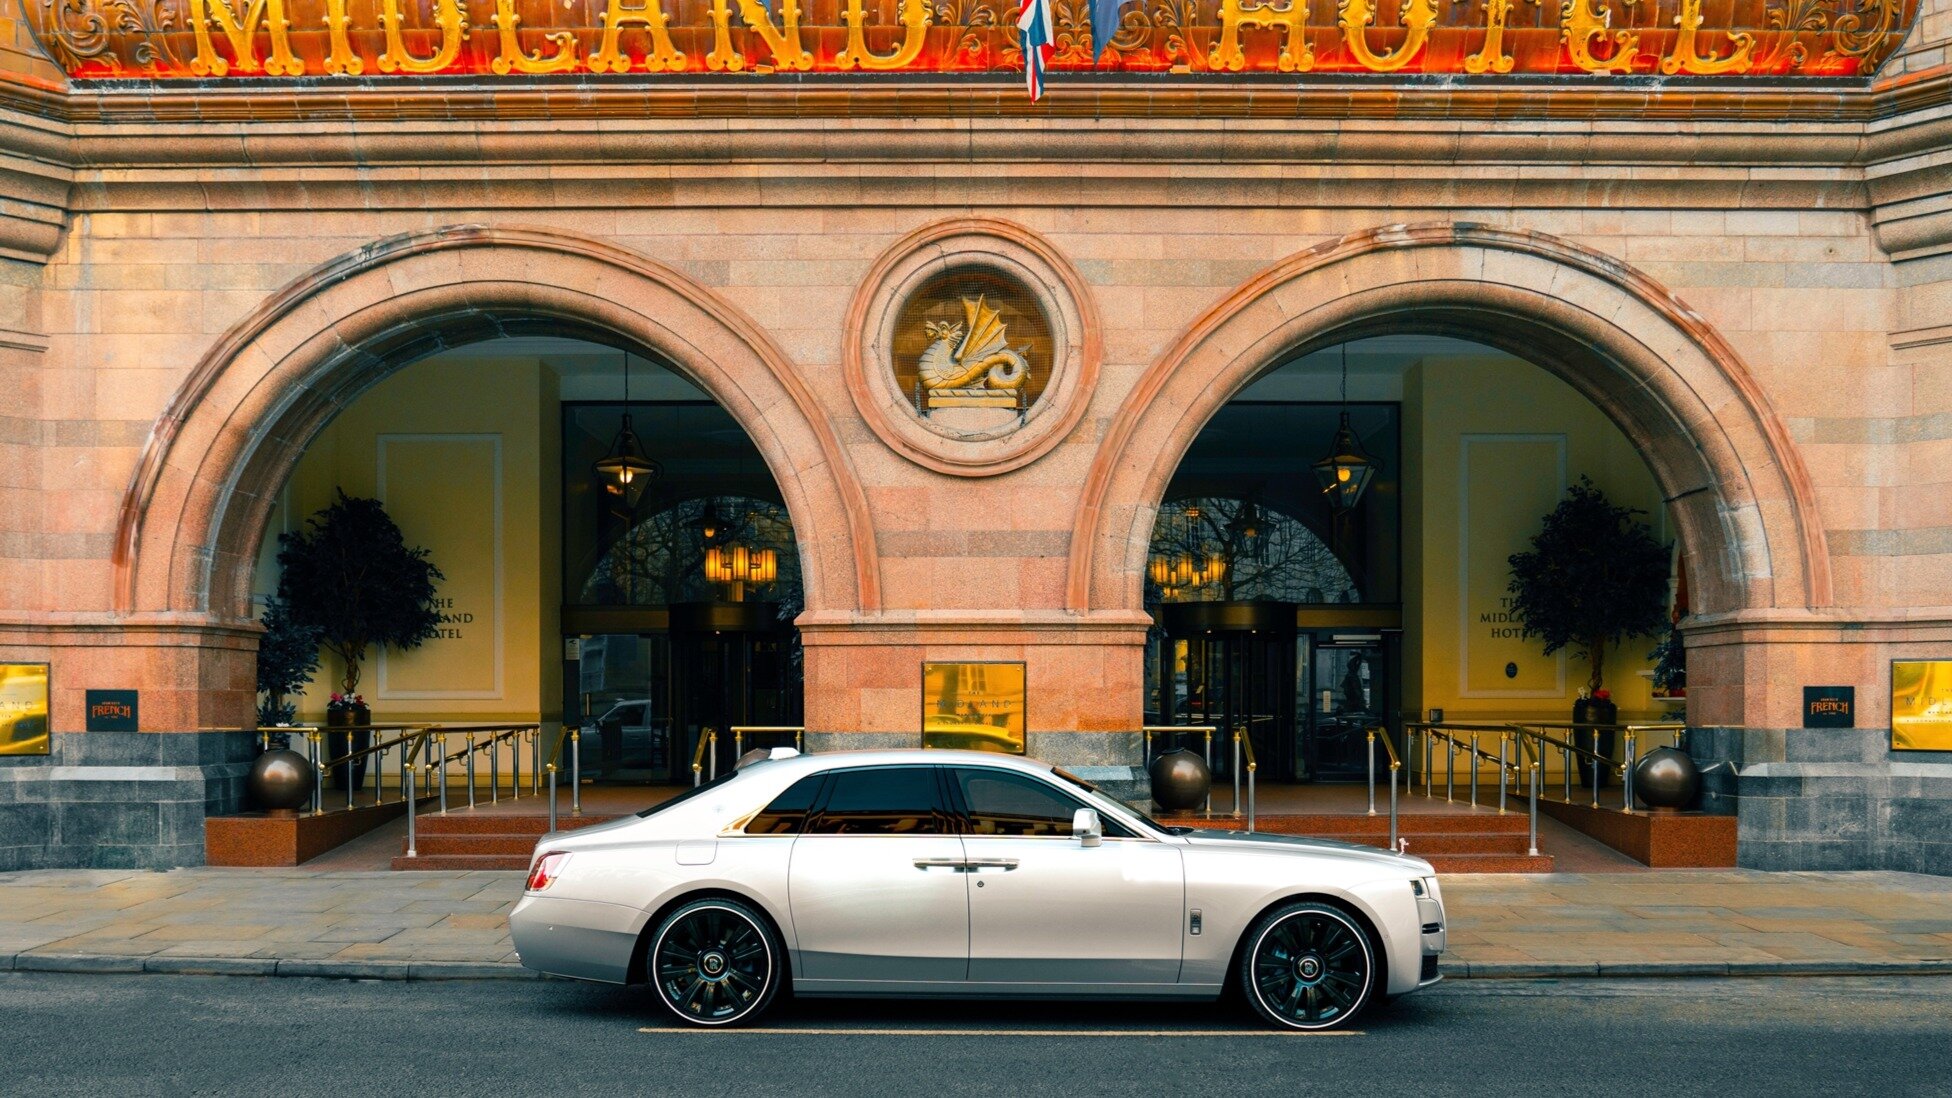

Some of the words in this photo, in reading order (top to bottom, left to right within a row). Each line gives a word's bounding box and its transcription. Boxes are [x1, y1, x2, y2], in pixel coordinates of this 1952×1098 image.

[430, 599, 453, 608] HE
[1480, 613, 1525, 623] MIDLA
[92, 704, 131, 719] FRENCH
[1811, 701, 1849, 715] FRENCH
